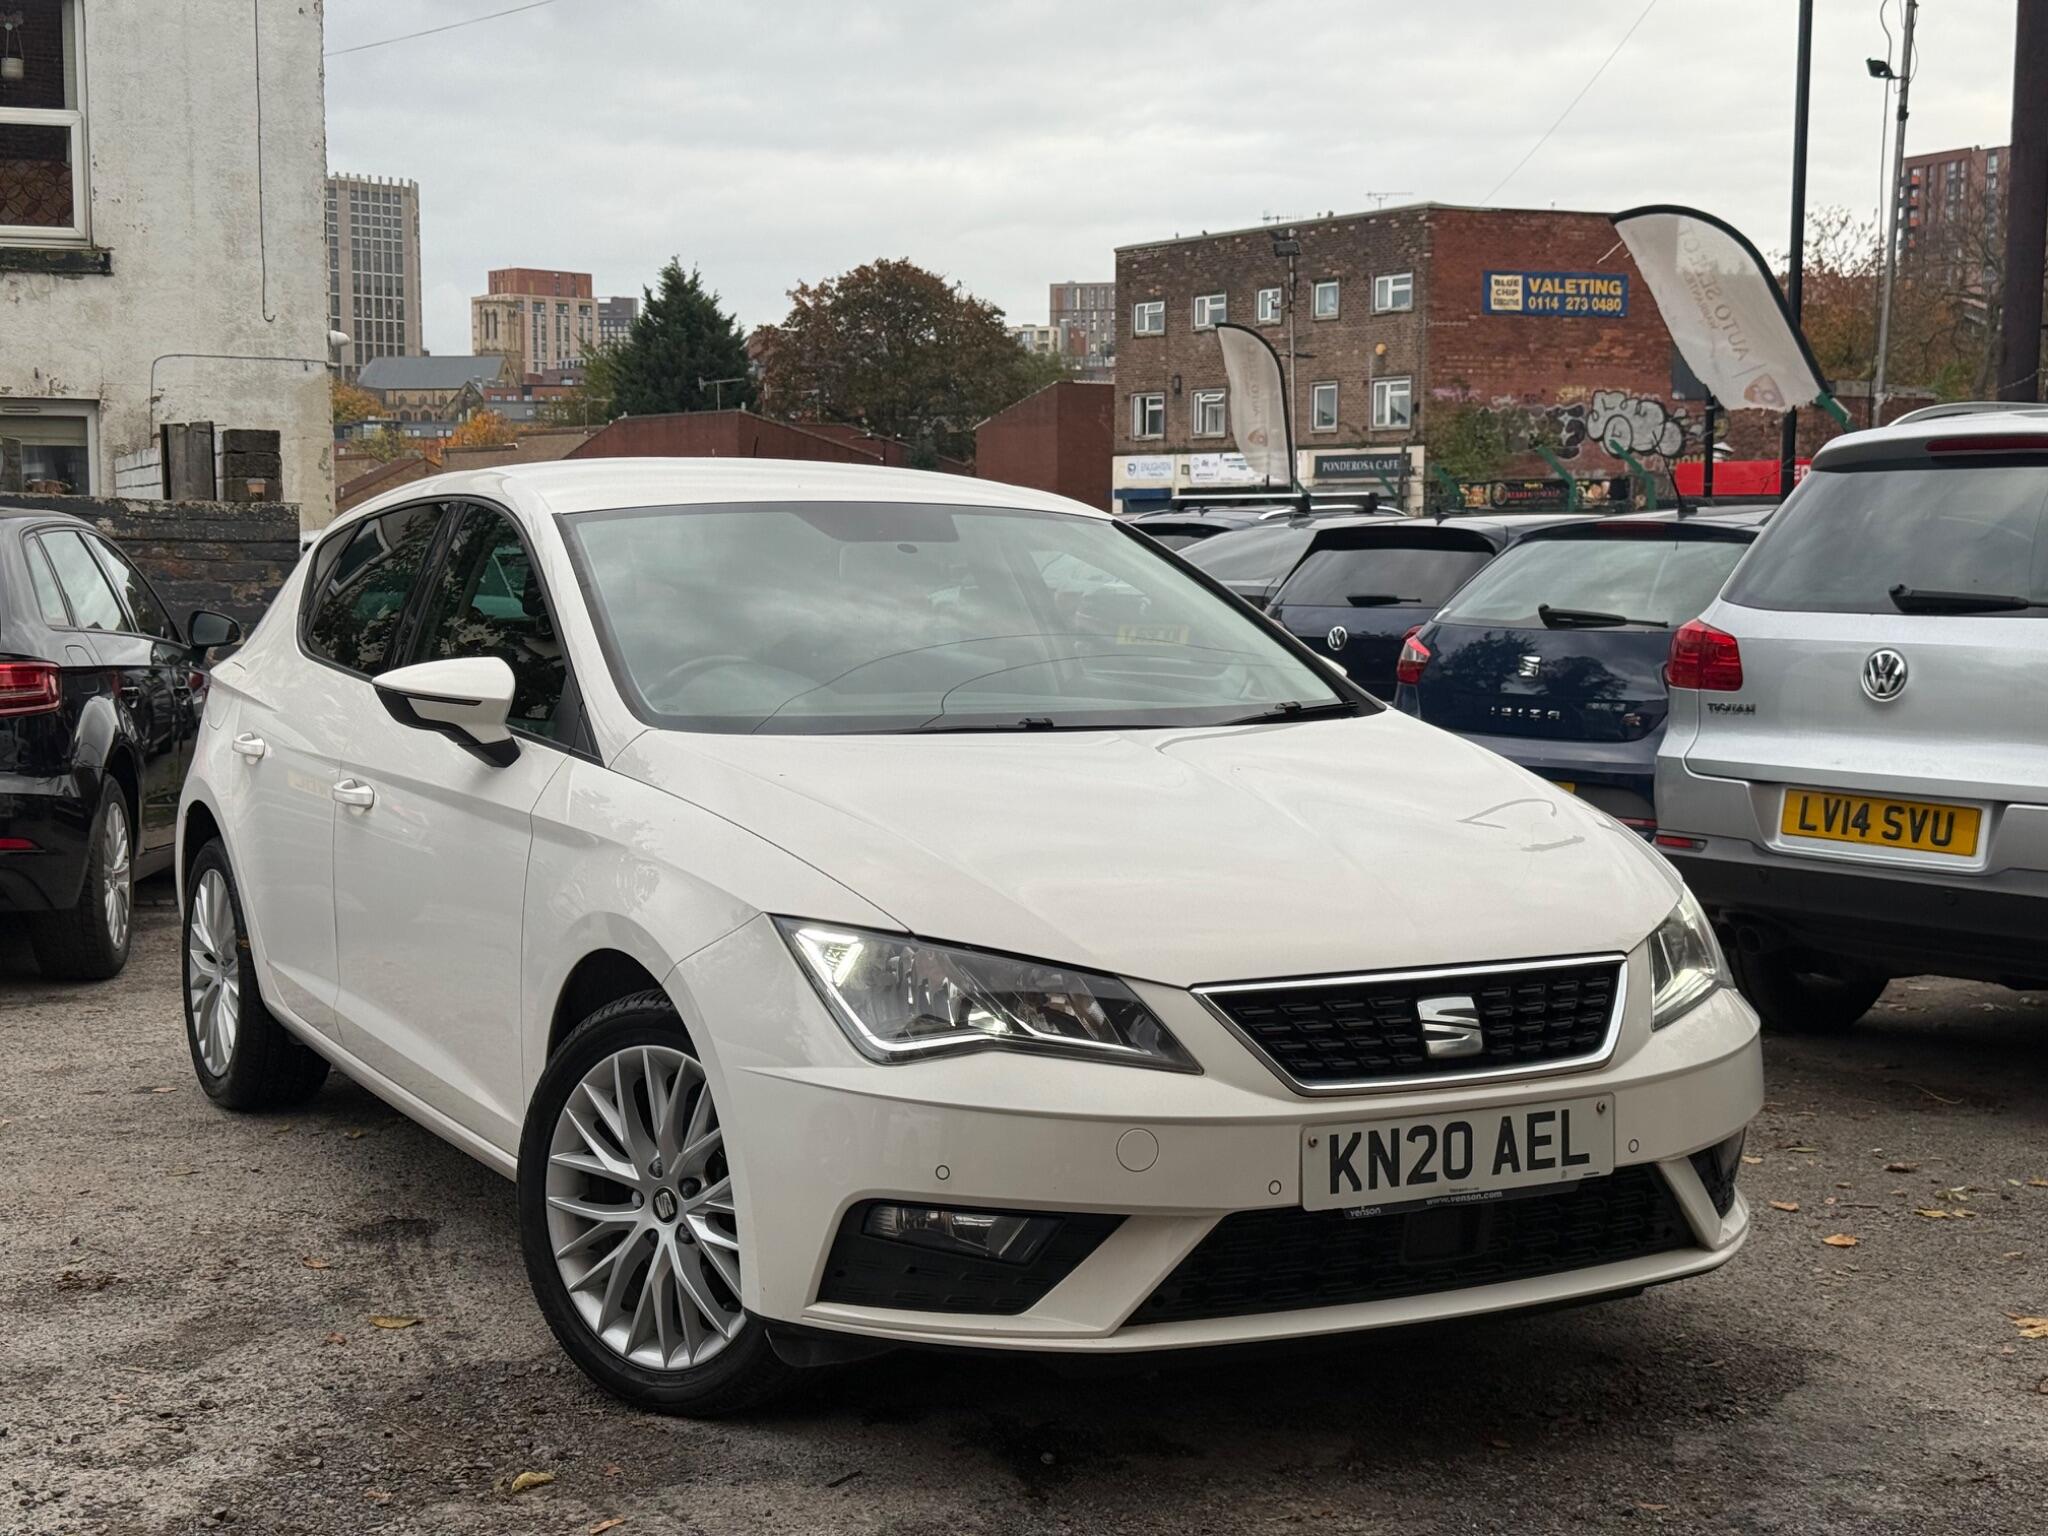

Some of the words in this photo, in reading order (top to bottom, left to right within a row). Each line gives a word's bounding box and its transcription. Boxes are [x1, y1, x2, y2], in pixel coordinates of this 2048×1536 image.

[1494, 278, 1519, 287] BLUE
[1528, 278, 1622, 295] VALETING
[1495, 288, 1518, 297] CHIP
[1528, 297, 1559, 310] 0114
[1565, 298, 1588, 311] 273
[1592, 298, 1622, 312] 0480
[1321, 460, 1374, 473] PONDEROSA
[1798, 796, 1870, 837] LV14
[1881, 806, 1954, 847] SVU
[1329, 1121, 1473, 1194] KN20
[1491, 1109, 1590, 1176] AEL
[1350, 1207, 1381, 1217] venson
